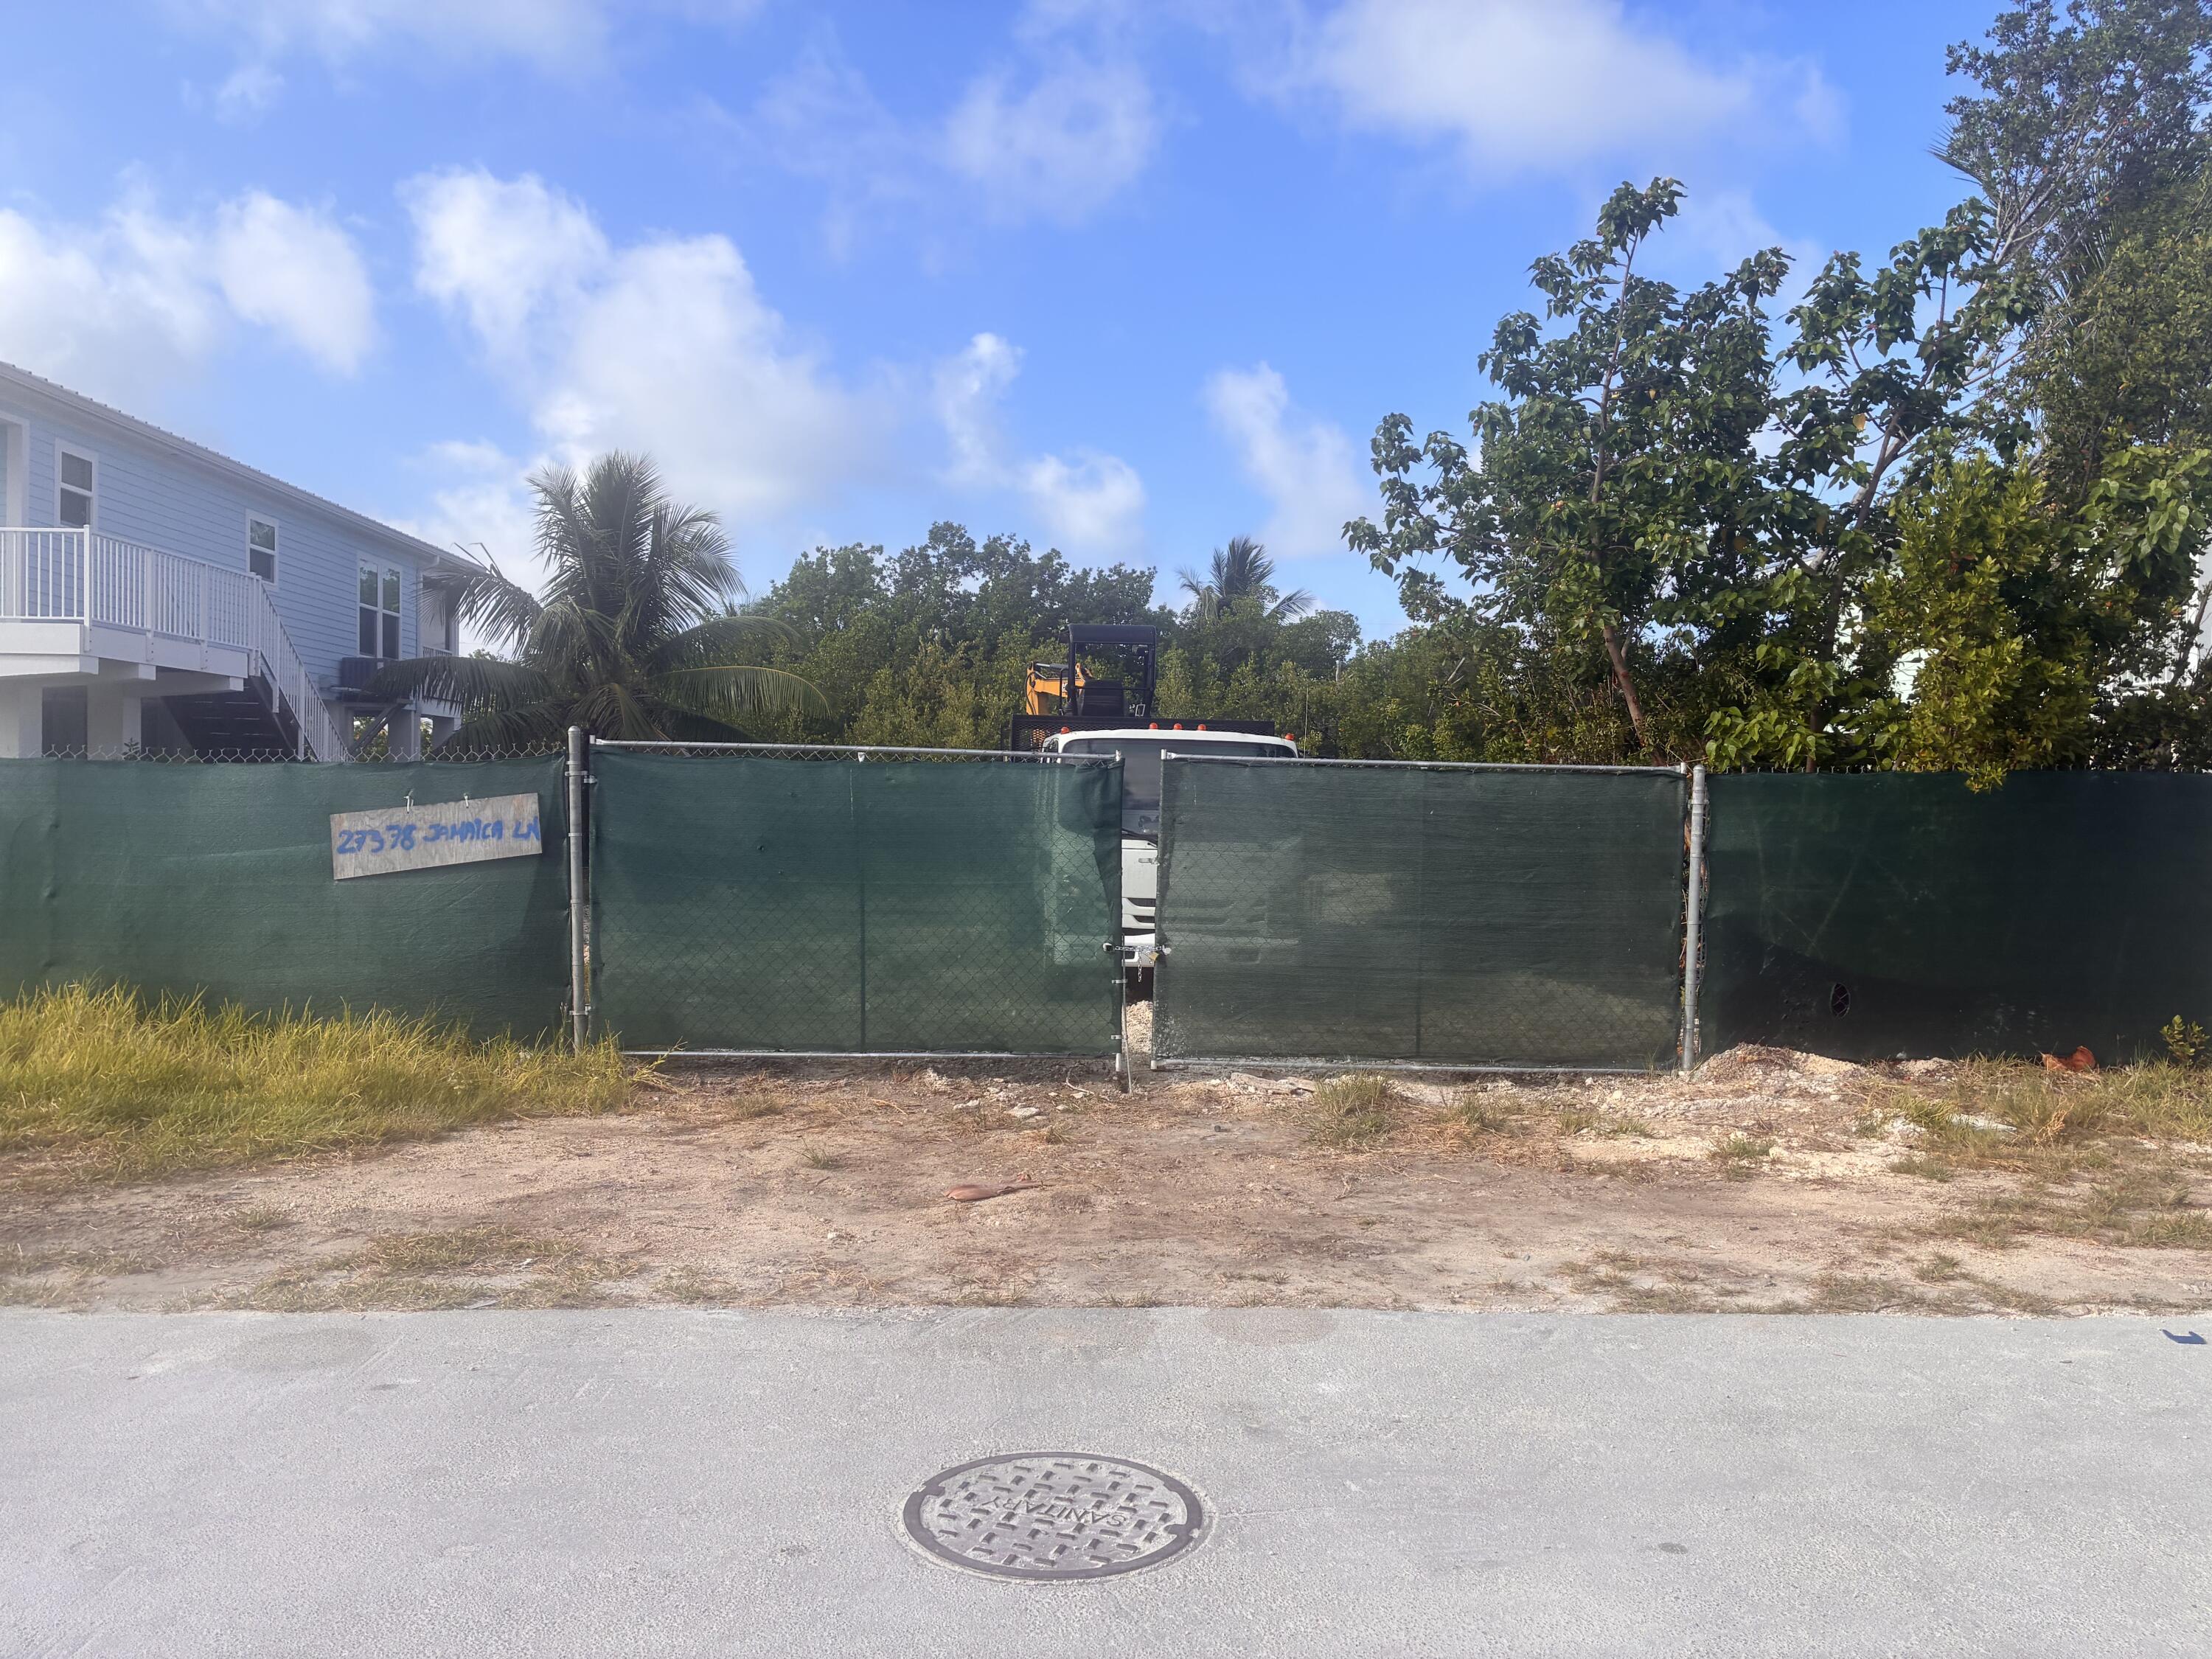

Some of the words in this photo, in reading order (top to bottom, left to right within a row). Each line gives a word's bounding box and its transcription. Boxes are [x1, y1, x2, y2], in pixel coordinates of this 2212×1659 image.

[336, 824, 417, 854] 27378
[423, 818, 503, 843] JAMAICA
[512, 816, 540, 841] LN
[982, 1496, 1126, 1527] SANITARY
